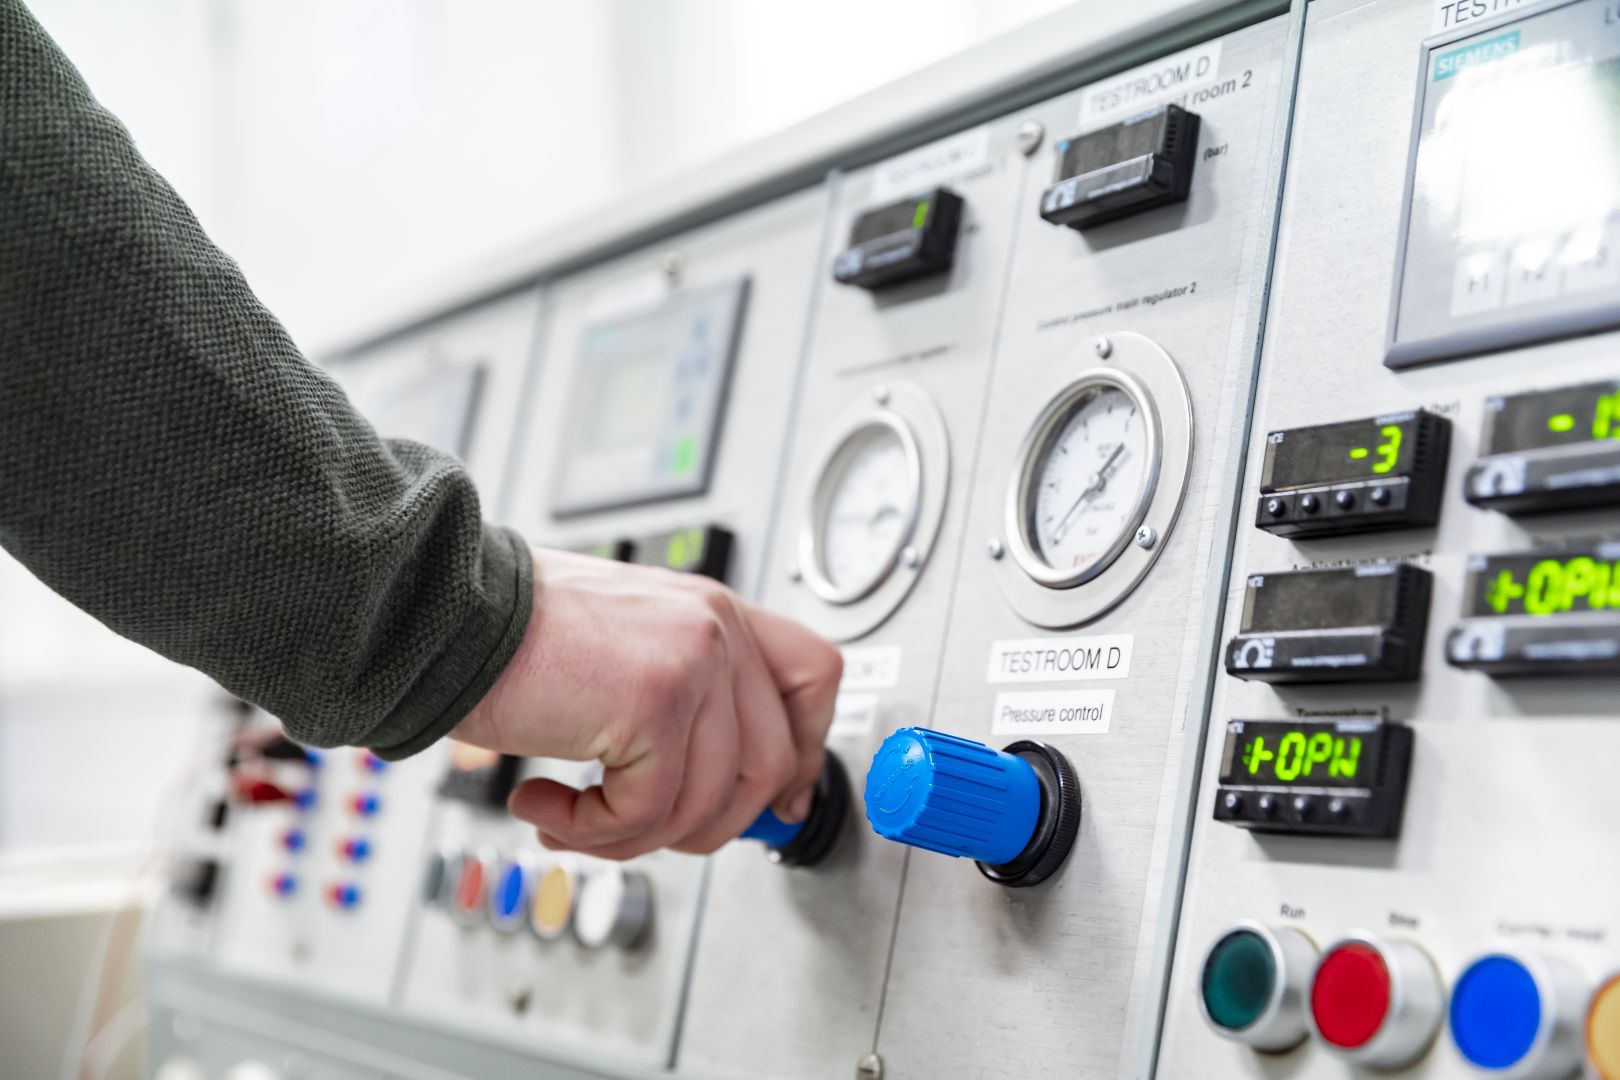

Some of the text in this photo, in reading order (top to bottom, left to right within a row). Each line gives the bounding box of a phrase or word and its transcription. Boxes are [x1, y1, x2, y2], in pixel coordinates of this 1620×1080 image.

[1196, 55, 1211, 78] D
[1437, 36, 1516, 77] SIEMENS
[1192, 79, 1236, 106] room
[1241, 69, 1253, 89] 2
[1203, 144, 1229, 161] (bar)
[1116, 298, 1139, 312] main
[1141, 286, 1188, 306] regulator
[1190, 281, 1197, 294] 2
[1002, 646, 1122, 674] TESTROOM D
[1002, 703, 1104, 723] Pressure control
[1280, 903, 1306, 919] Run
